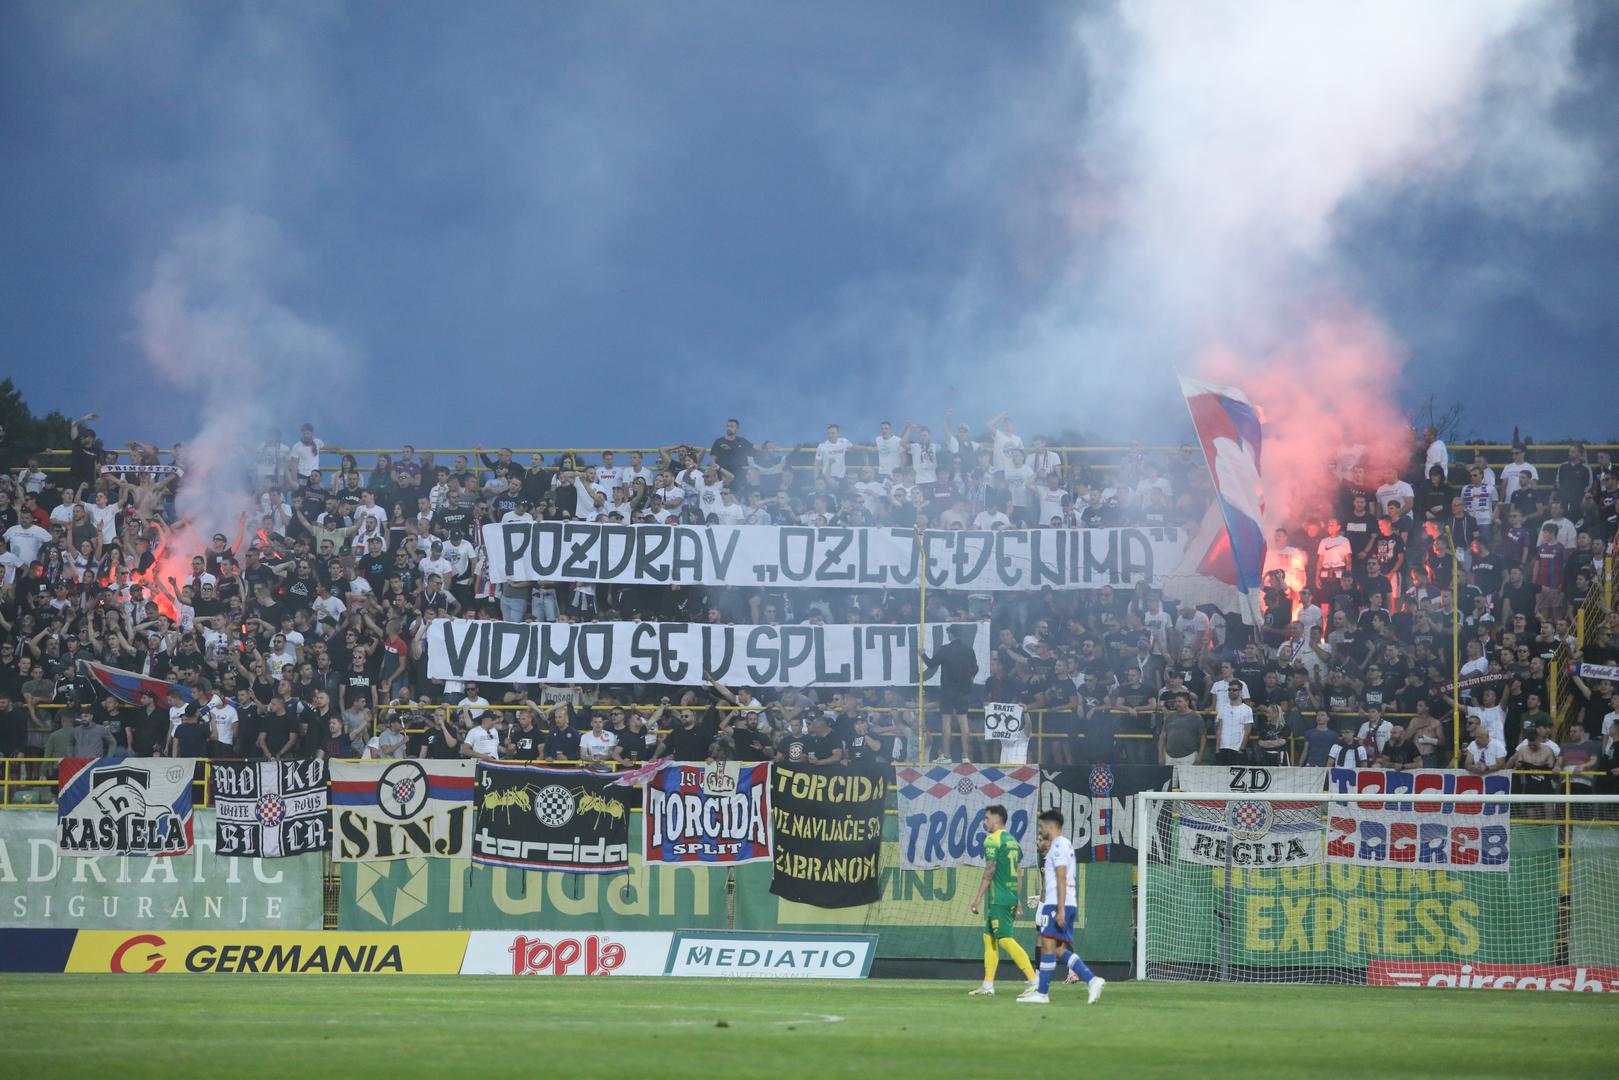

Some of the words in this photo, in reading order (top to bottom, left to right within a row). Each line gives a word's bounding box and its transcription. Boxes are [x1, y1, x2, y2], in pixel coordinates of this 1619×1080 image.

[502, 521, 740, 582] POZDRAV
[443, 621, 614, 680] VIDIMO
[630, 622, 689, 682] SE
[701, 626, 734, 682] U
[540, 786, 571, 801] HAJDUK
[776, 766, 884, 803] TORCIDA
[1229, 766, 1272, 792] ZD
[1331, 768, 1511, 816] TORCIDA
[220, 803, 249, 818] WHITE
[541, 814, 566, 826] SPLIT
[650, 781, 766, 847] TORCIDA
[792, 814, 865, 841] NAVIJAČE
[340, 805, 468, 859] SINJ
[475, 827, 628, 863] torcida
[673, 842, 742, 855] SPLIT
[905, 805, 1028, 863] TROGR
[1192, 833, 1309, 866] REGIJA
[1326, 816, 1509, 865] ZAGREB
[1245, 896, 1481, 955] EXPRESS
[185, 944, 404, 973] GERMANIA
[685, 946, 856, 969] MEDIATIO
